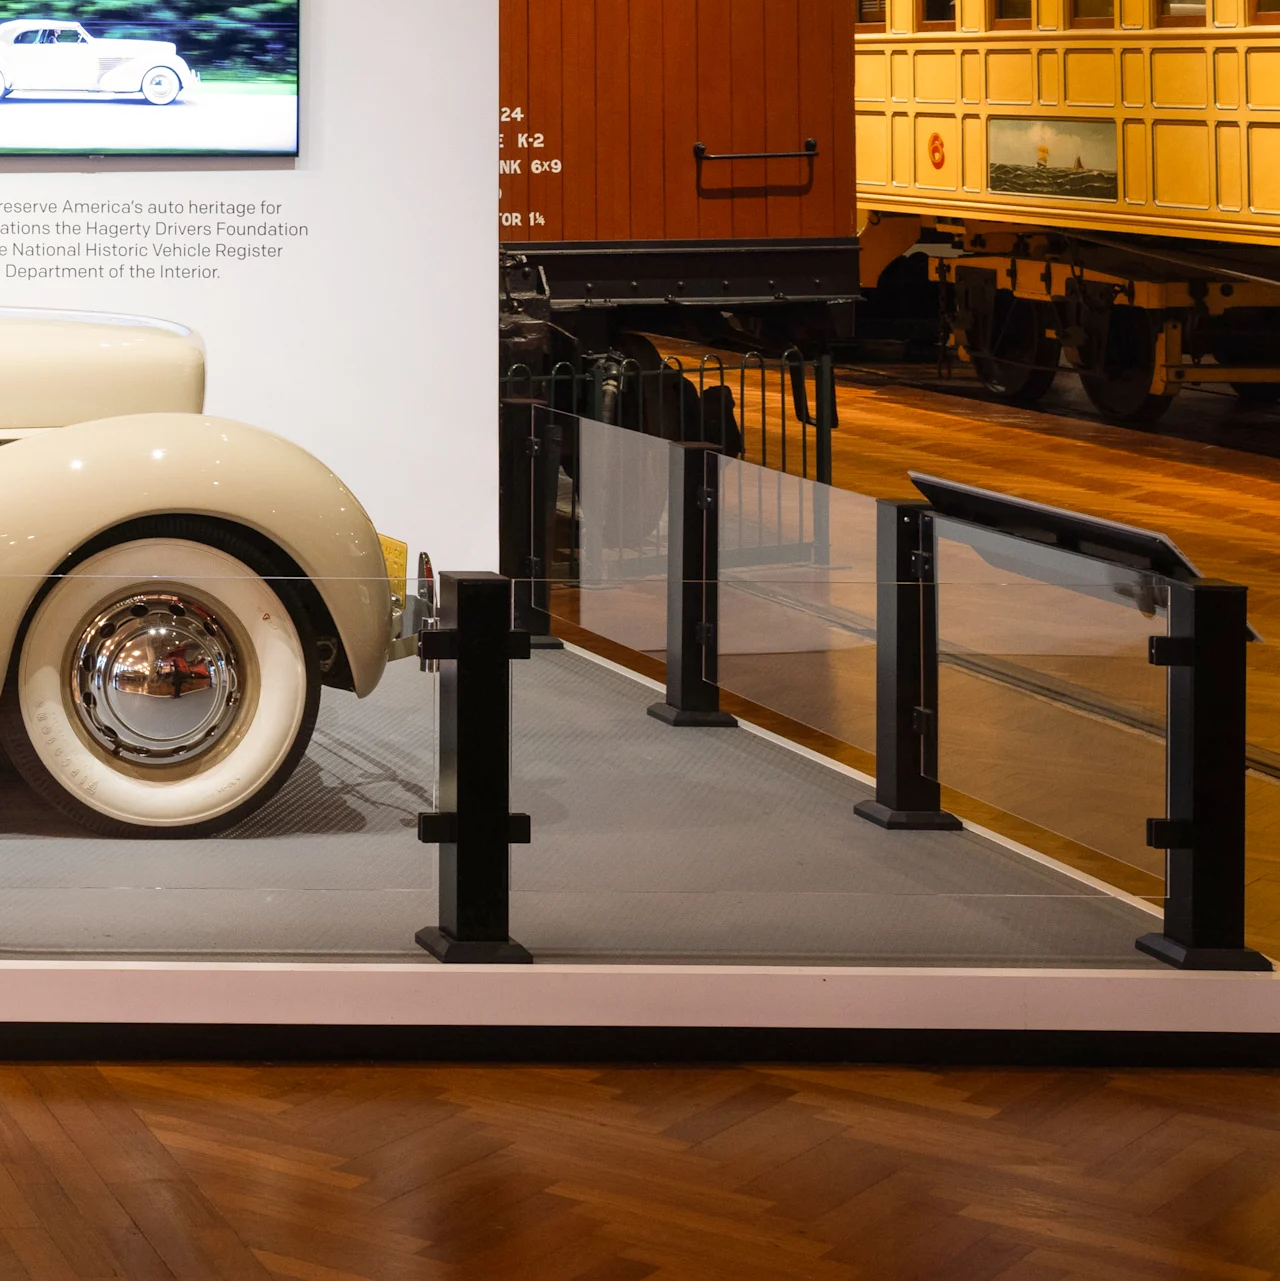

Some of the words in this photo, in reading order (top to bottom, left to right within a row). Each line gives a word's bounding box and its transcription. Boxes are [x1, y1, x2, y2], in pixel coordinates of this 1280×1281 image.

[500, 106, 525, 122] 24
[517, 132, 545, 148] K-2
[927, 132, 946, 170] 6
[62, 199, 143, 215] America's
[147, 200, 184, 215] auto
[188, 199, 256, 218] heritage
[260, 200, 283, 215] for
[55, 220, 81, 236] the
[86, 221, 151, 240] Hagerty
[155, 221, 212, 237] Drivers
[216, 221, 309, 237] Foundation
[12, 242, 81, 258] National
[86, 242, 148, 258] Historic
[152, 242, 211, 258] Vehicle
[215, 243, 284, 262] Register
[5, 263, 105, 283] Department
[108, 263, 125, 279] of
[129, 264, 156, 279] the
[160, 264, 221, 280] Interior.
